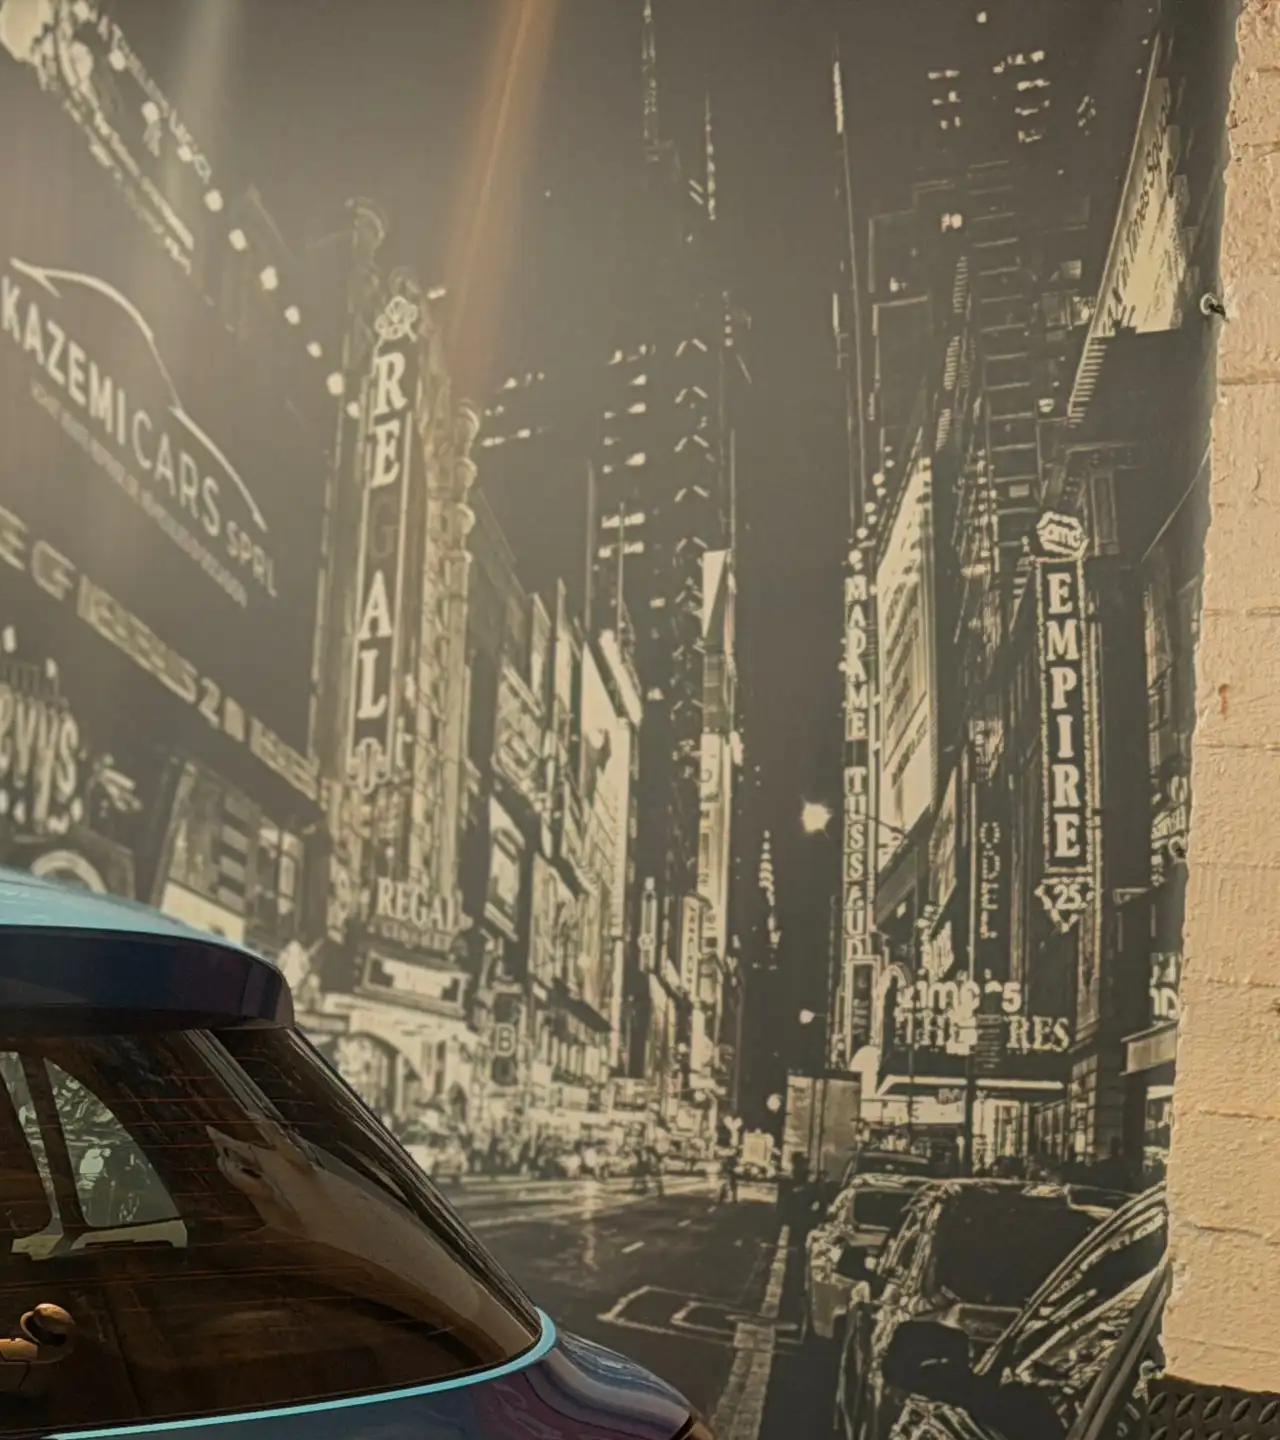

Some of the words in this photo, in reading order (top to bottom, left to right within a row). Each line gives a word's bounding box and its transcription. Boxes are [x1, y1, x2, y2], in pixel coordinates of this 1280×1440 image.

[1, 275, 127, 447] KAZEMI
[132, 409, 221, 538] CARS
[357, 351, 407, 720] REGAL
[844, 575, 870, 738] MADAME
[1045, 572, 1081, 858] EMPIRE
[1052, 882, 1082, 910] 25
